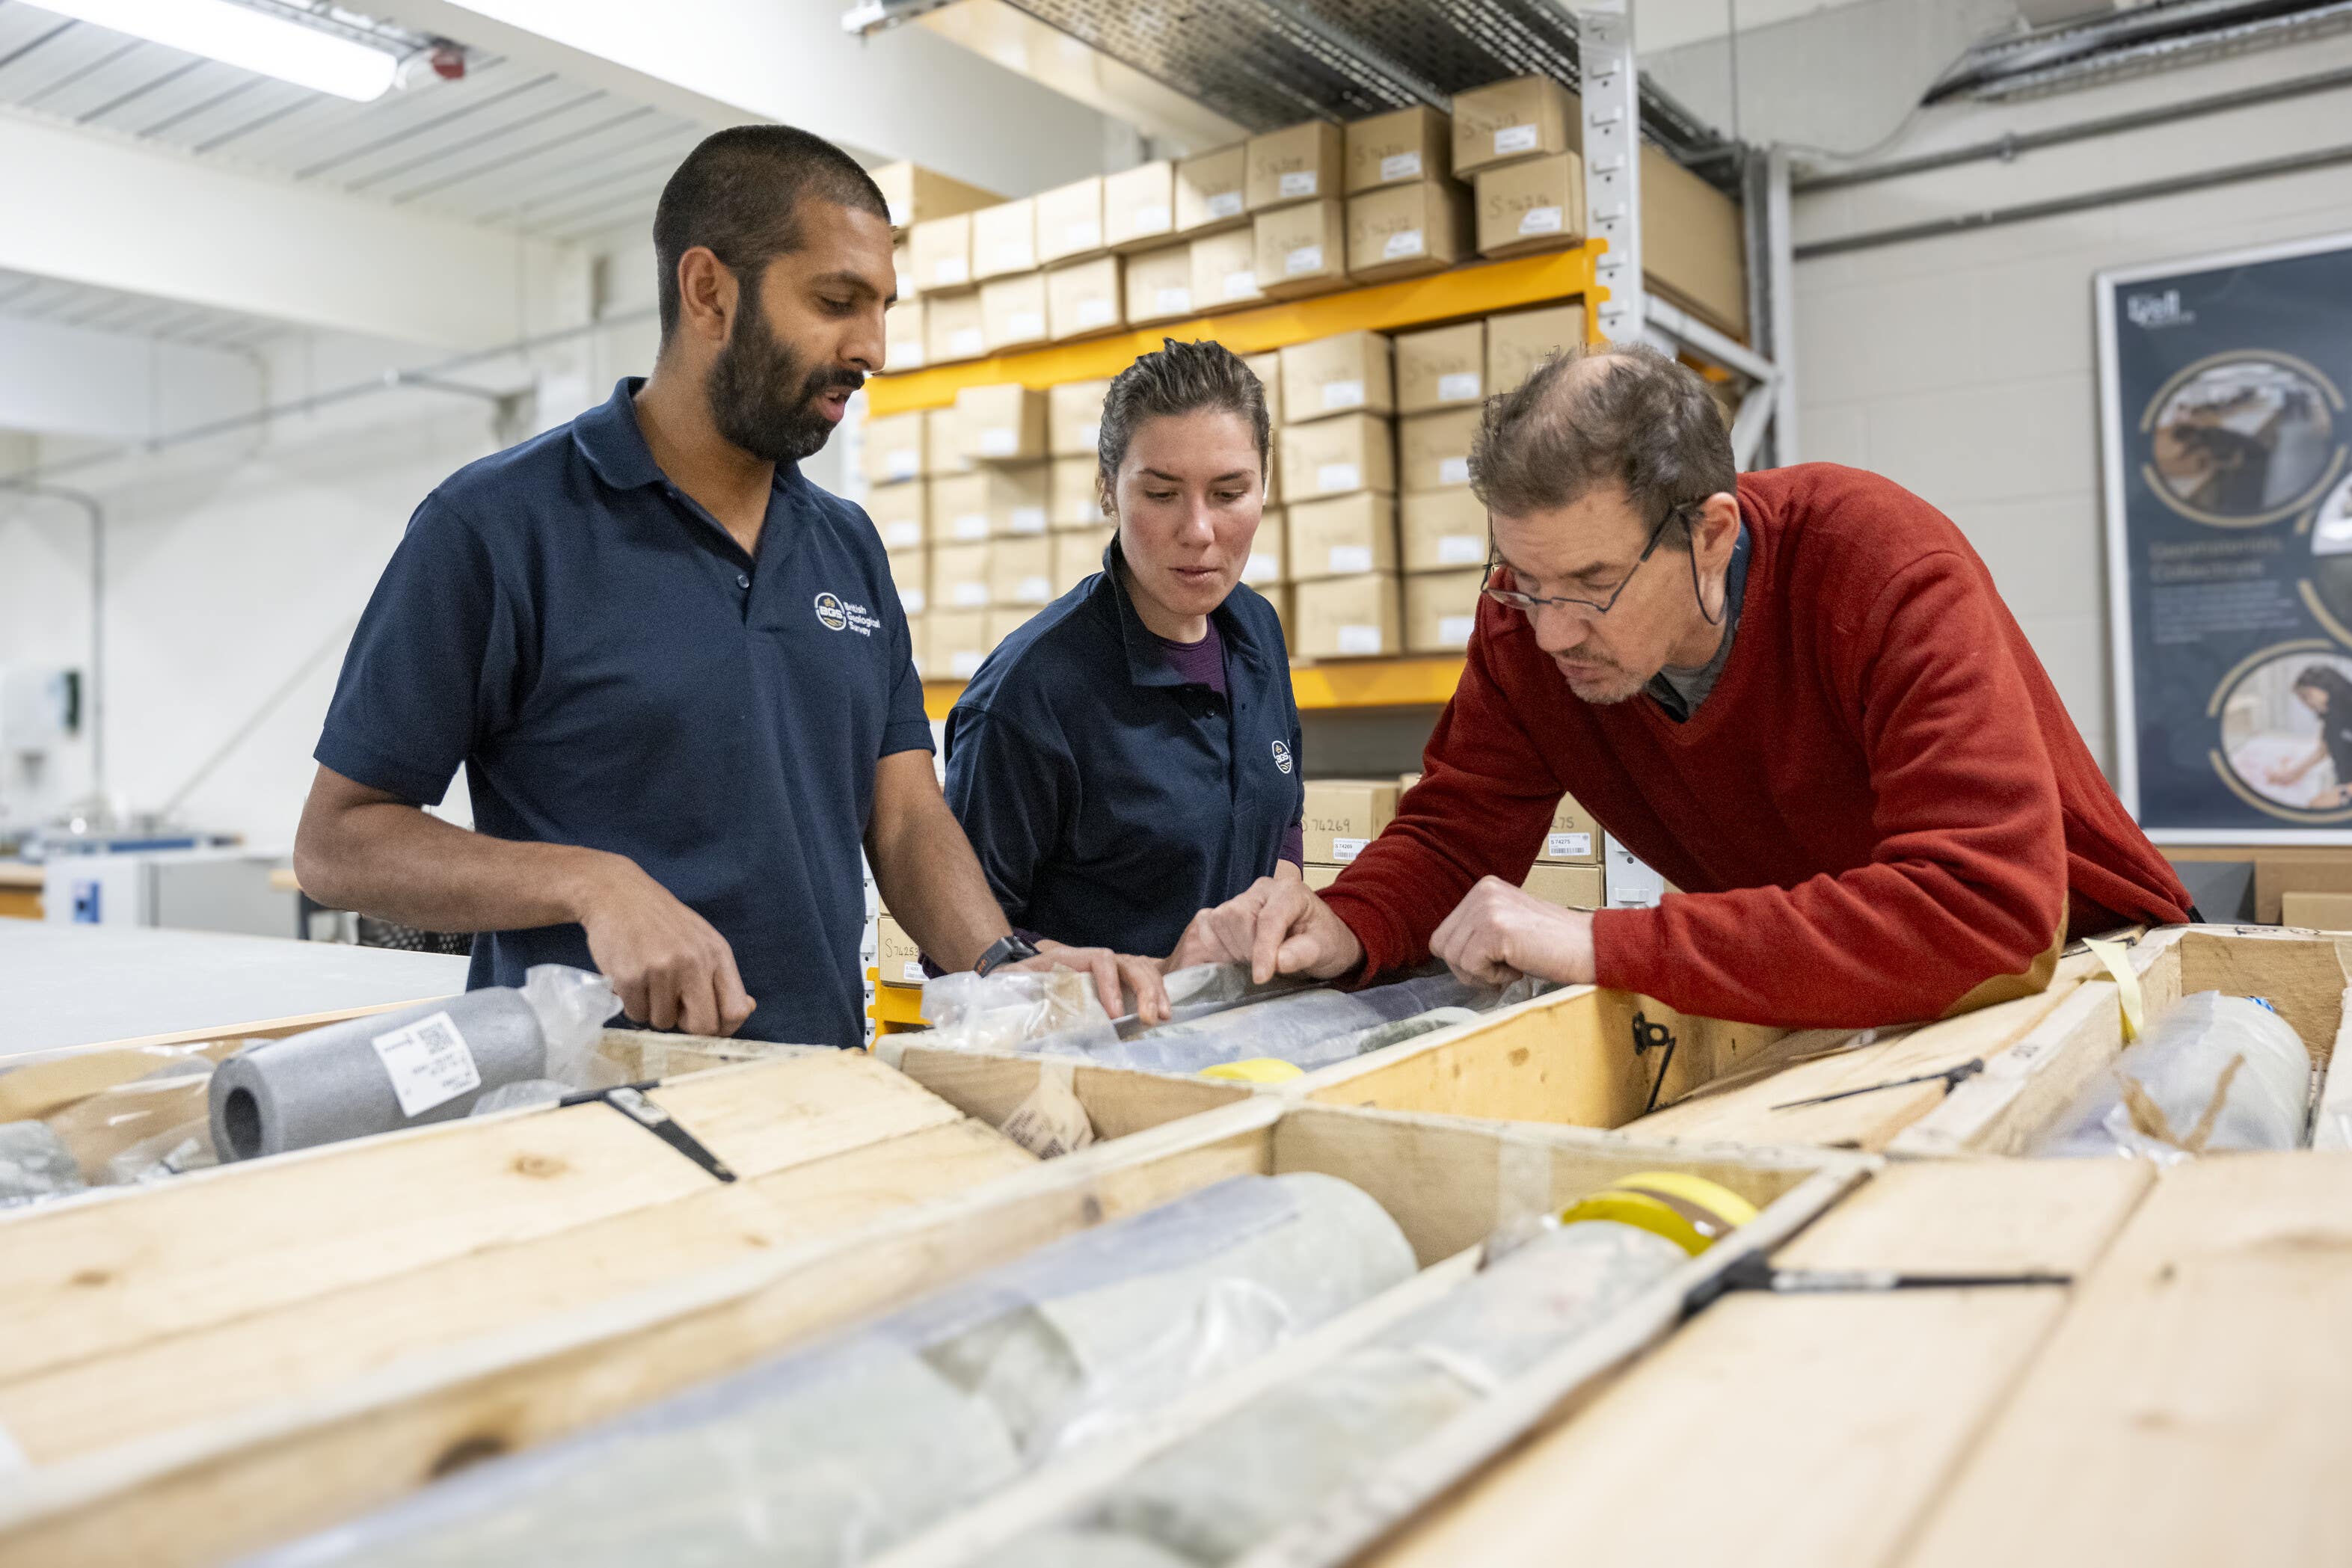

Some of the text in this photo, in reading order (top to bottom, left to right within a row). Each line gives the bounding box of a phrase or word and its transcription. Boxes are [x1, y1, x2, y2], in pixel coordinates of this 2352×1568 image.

[819, 606, 843, 619] BGS
[843, 602, 867, 615] British
[847, 611, 881, 628] Geological
[848, 621, 871, 637] Survey
[1276, 751, 1289, 763] BGS
[1312, 818, 1350, 833] 74269
[885, 938, 893, 958] S
